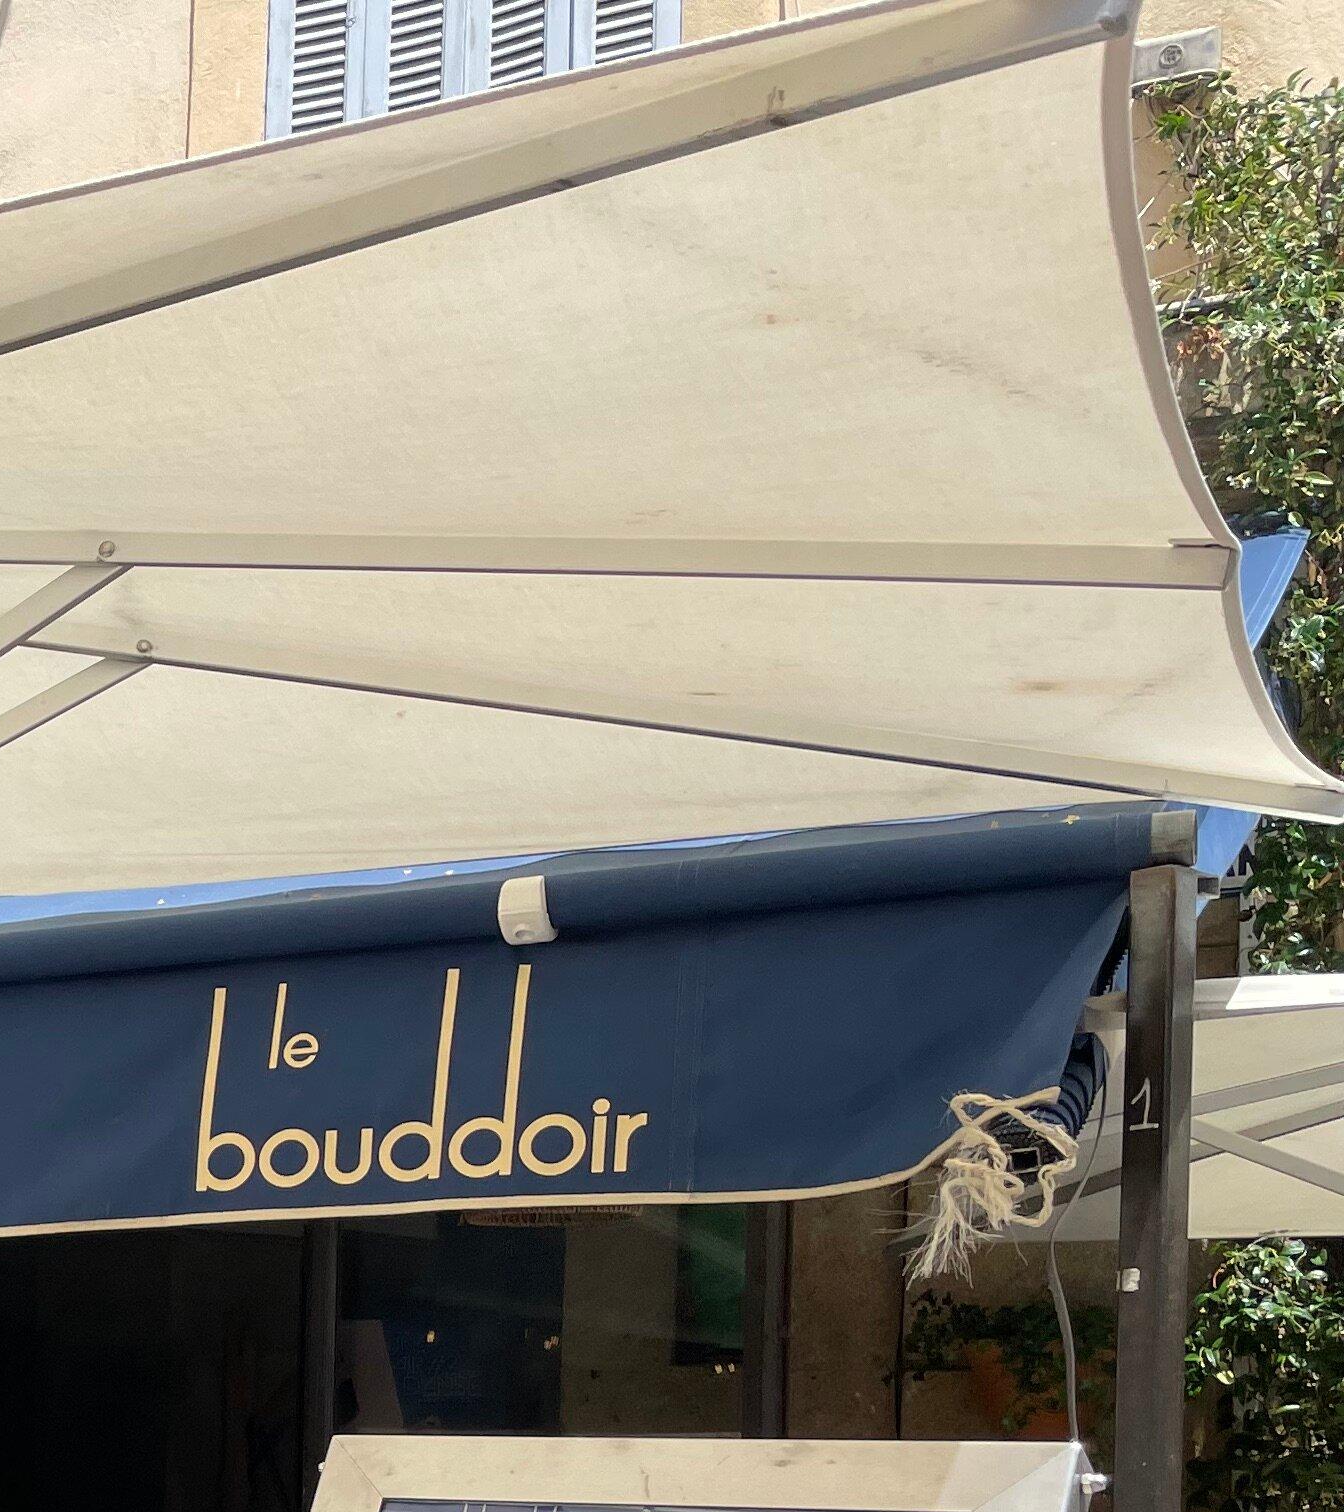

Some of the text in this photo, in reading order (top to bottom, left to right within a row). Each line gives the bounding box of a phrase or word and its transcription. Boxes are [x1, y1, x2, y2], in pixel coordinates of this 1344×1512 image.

[268, 983, 319, 1069] le
[196, 964, 648, 1192] bouddoir
[1129, 1078, 1159, 1131] 1
